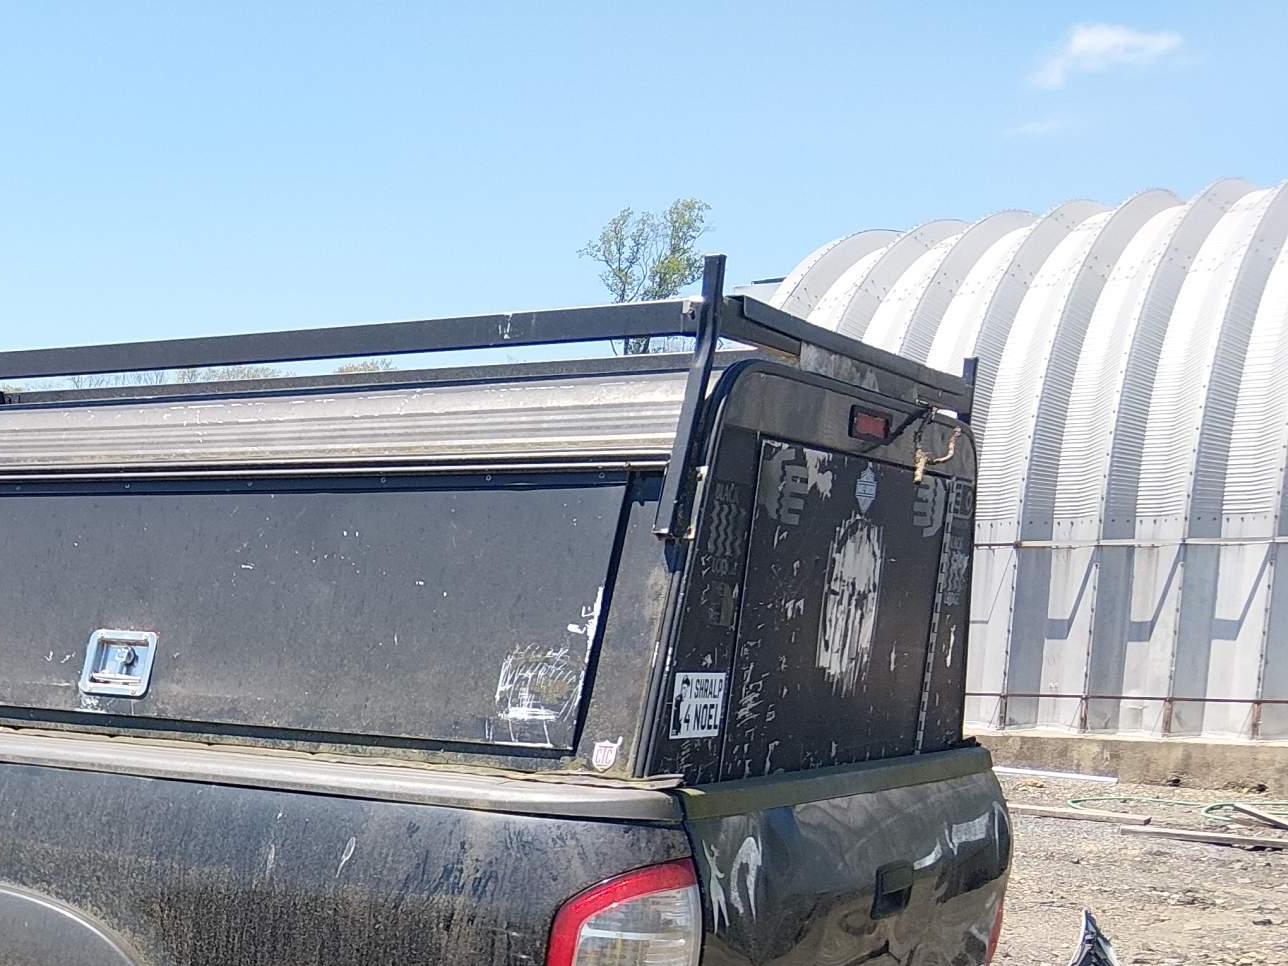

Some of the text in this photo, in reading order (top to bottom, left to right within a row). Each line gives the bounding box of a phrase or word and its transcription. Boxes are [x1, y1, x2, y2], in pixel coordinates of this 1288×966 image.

[694, 678, 723, 699] SHRALP
[683, 703, 719, 731] 4 NOEL
